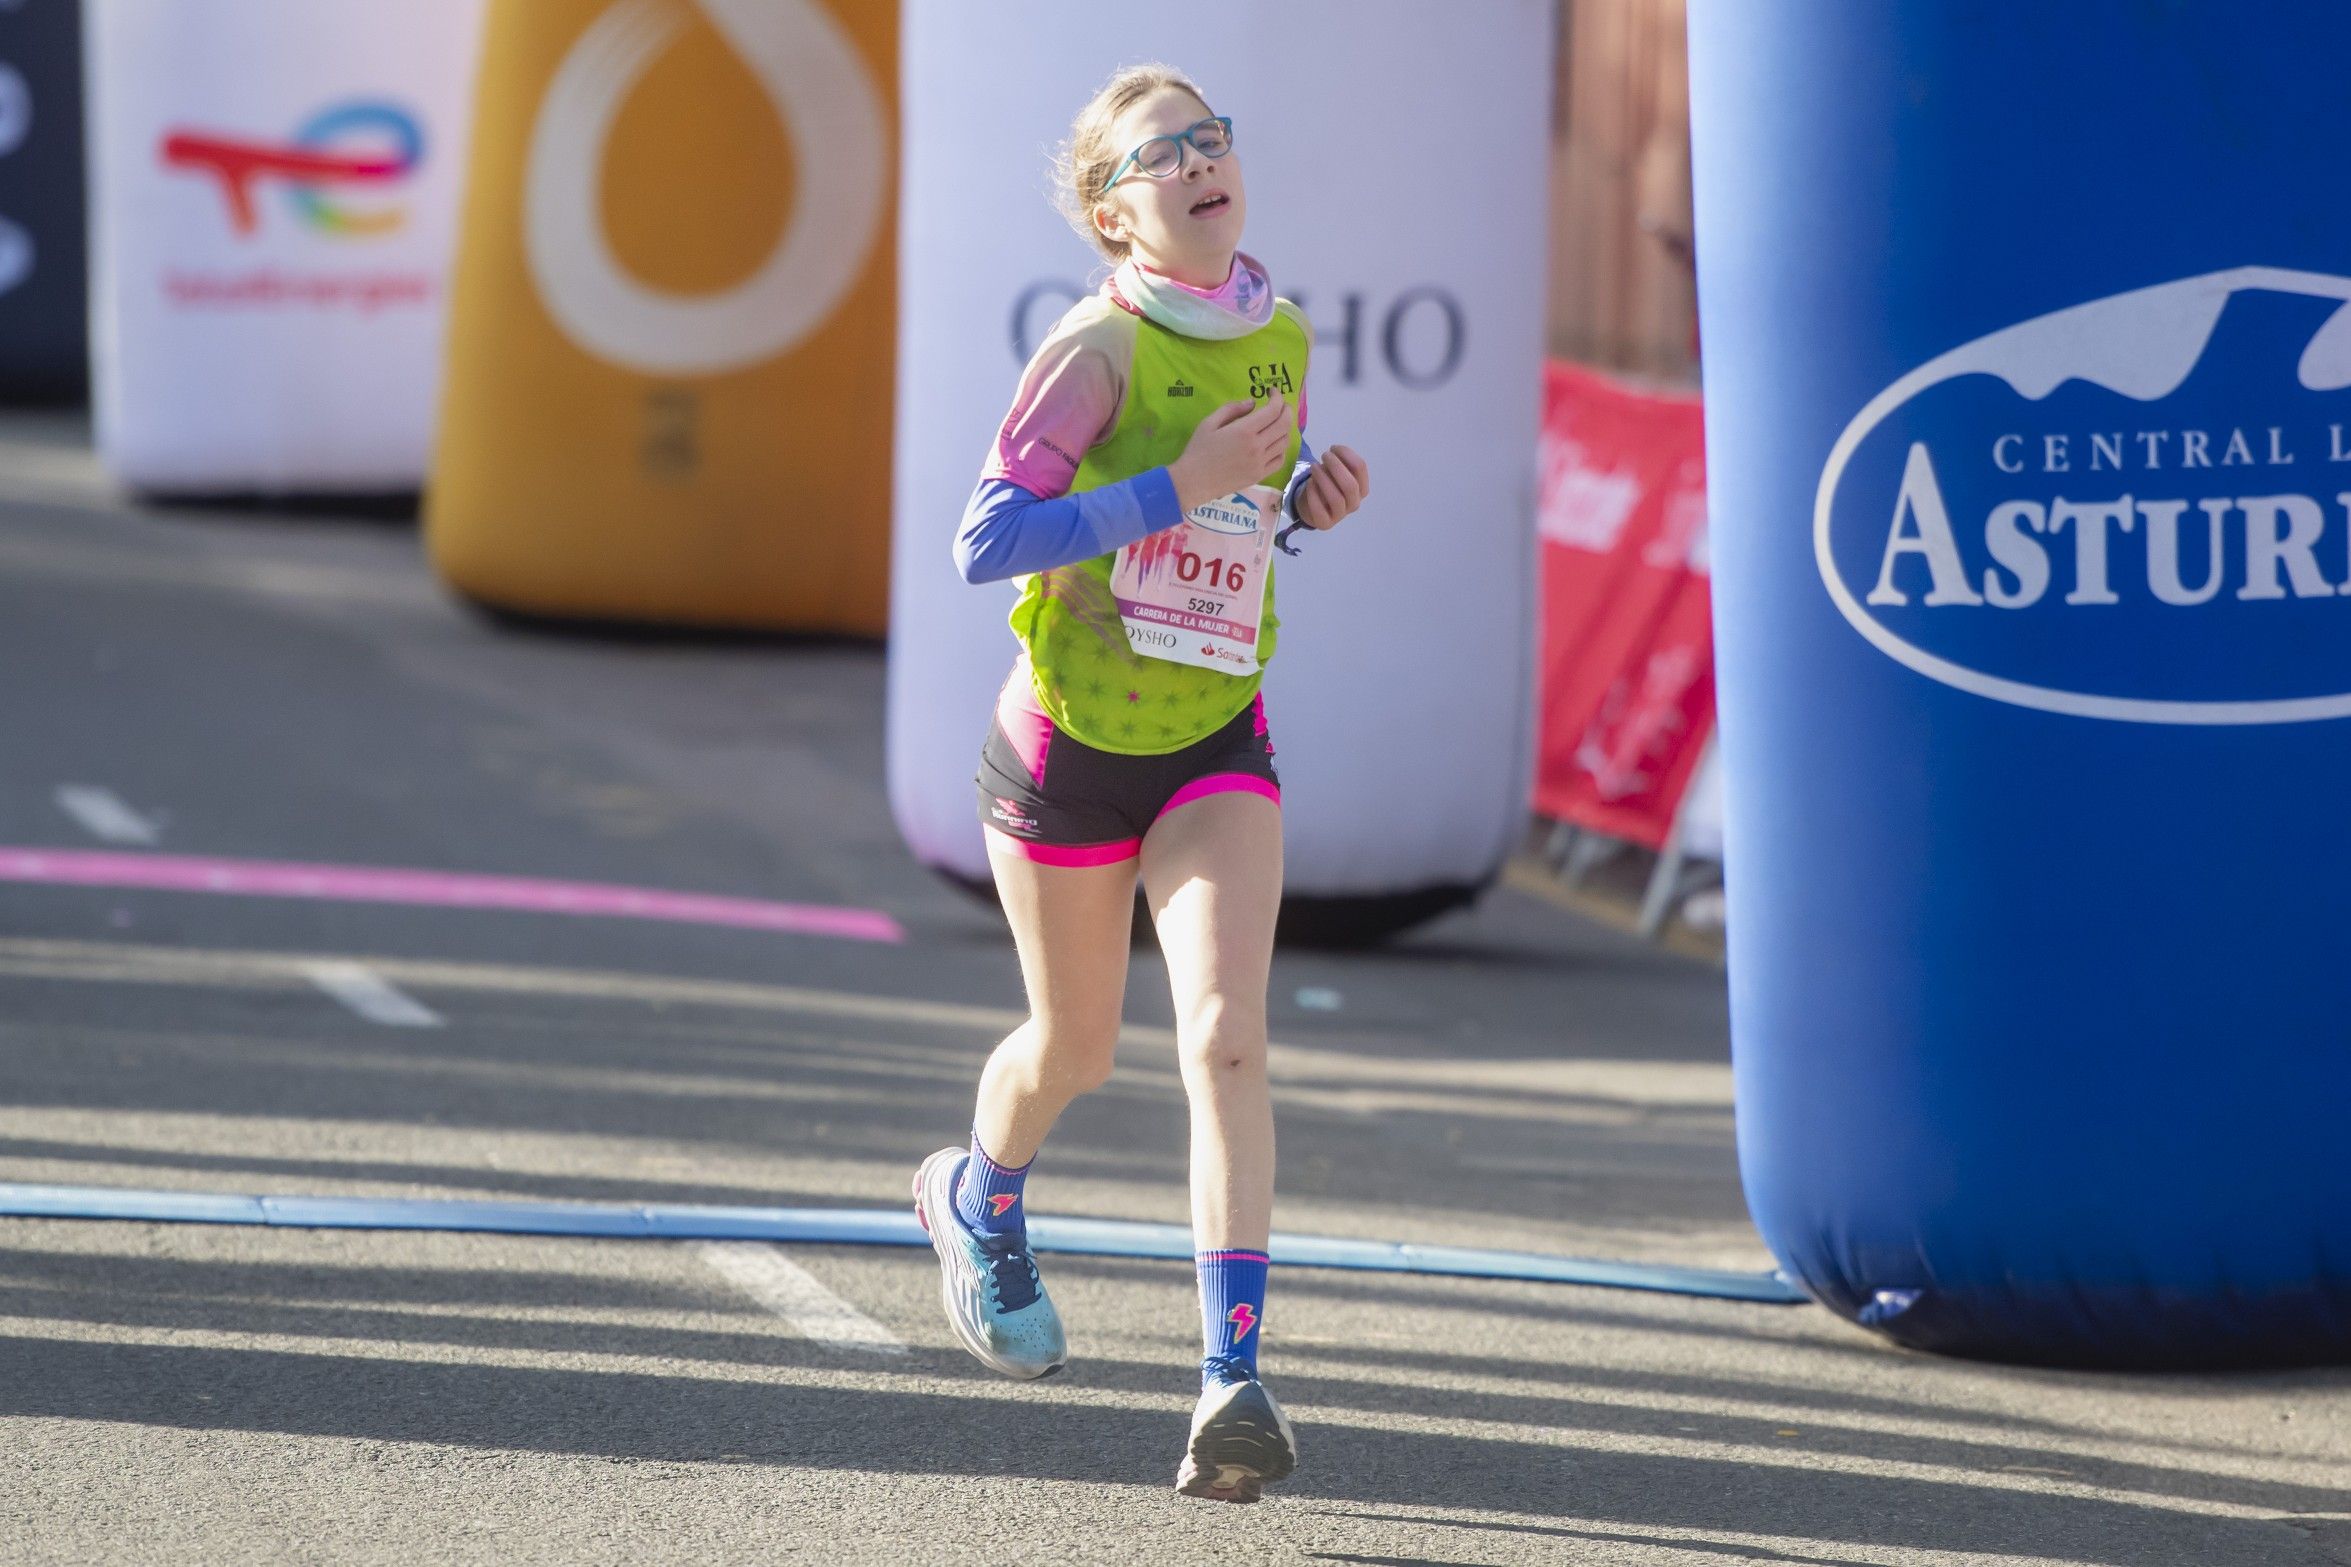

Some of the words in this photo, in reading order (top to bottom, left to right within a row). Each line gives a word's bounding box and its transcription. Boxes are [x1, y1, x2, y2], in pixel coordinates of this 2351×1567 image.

[1993, 427, 2294, 473] CENTRAL
[1866, 441, 2351, 609] ASTUR
[1176, 552, 1246, 592] 016
[1134, 606, 1168, 621] CARRERA
[1169, 614, 1181, 624] DE
[1183, 617, 1196, 627] LA
[1198, 619, 1230, 634] MUJER
[1188, 598, 1224, 616] 5297
